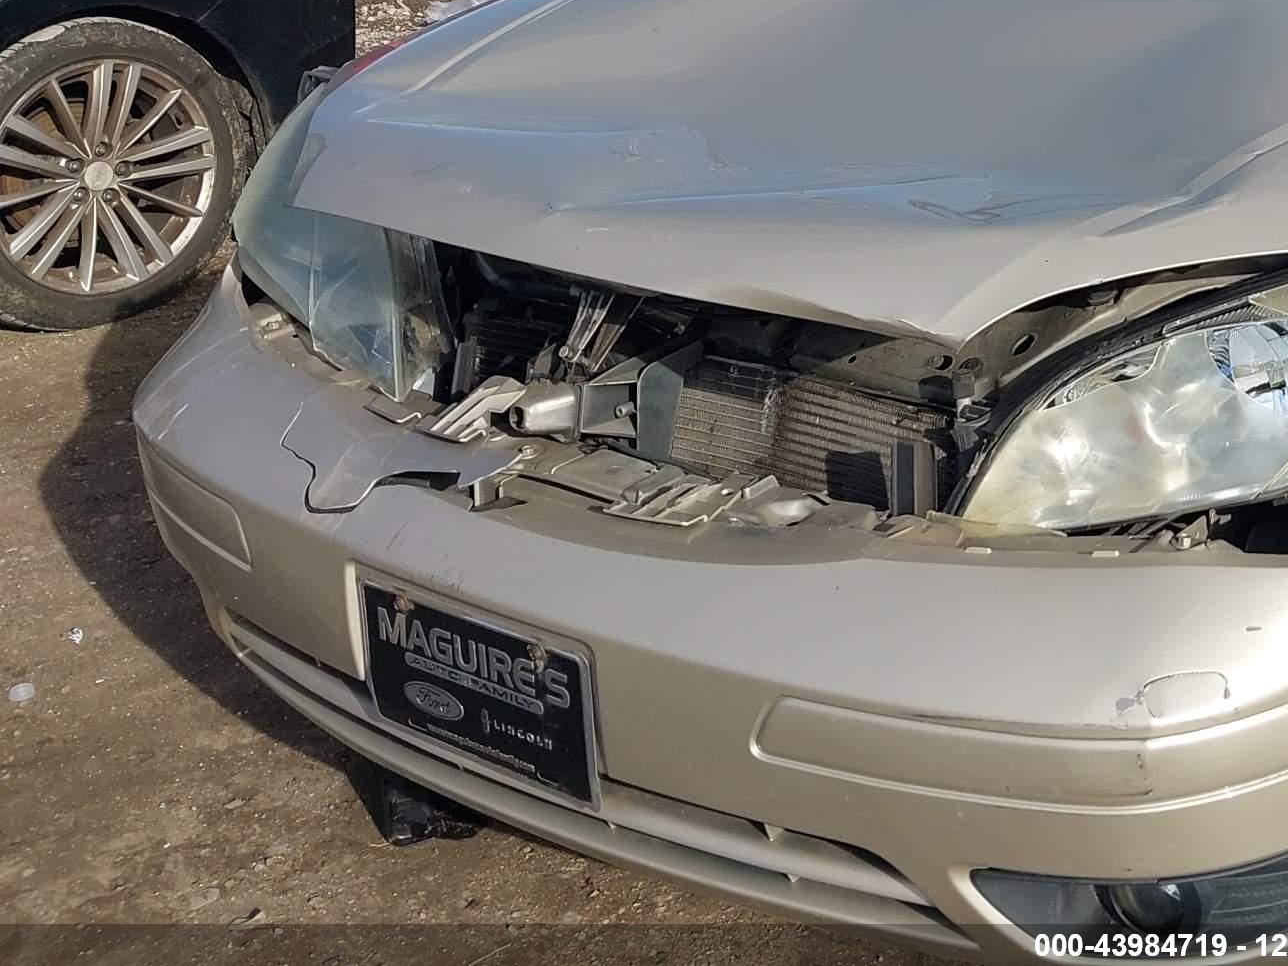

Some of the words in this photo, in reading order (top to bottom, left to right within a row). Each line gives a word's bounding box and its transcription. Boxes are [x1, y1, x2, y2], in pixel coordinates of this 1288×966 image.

[376, 606, 571, 710] MAGUIRE'S
[409, 655, 462, 681] AUTO
[466, 677, 537, 709] FAMILY
[416, 686, 451, 715] Ford
[493, 719, 553, 751] LINCOLN
